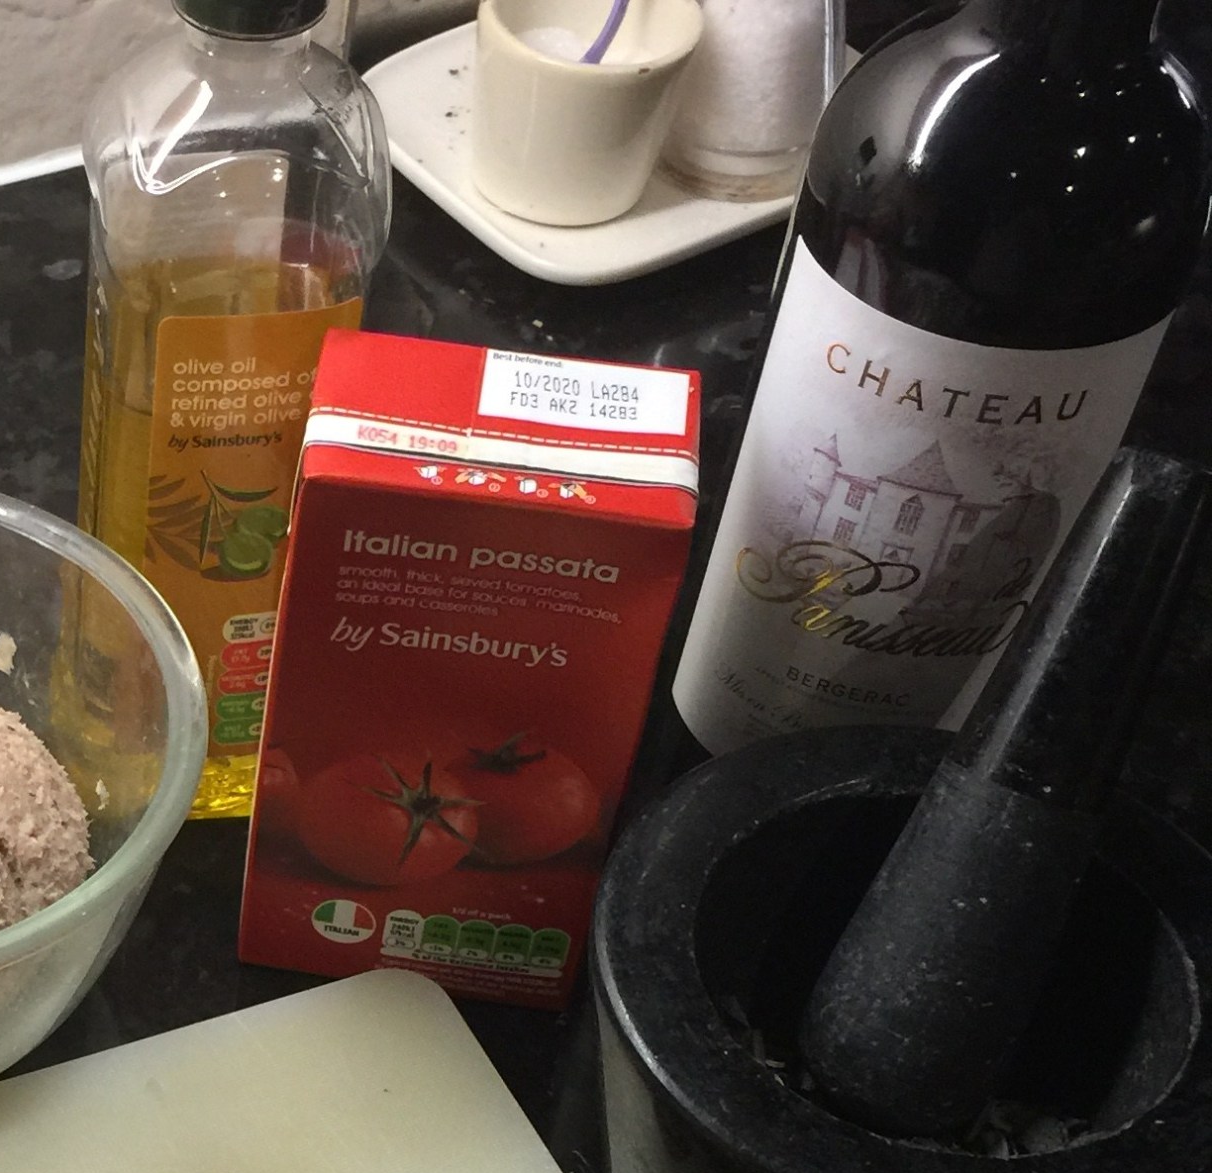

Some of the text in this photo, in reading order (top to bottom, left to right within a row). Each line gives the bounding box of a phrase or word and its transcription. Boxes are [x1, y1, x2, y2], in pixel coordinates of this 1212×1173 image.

[173, 357, 256, 375] olive oil
[515, 355, 543, 366] before
[173, 371, 290, 394] composed
[514, 370, 640, 404] 10/2020 LA284
[827, 343, 1088, 425] CHATEAU
[171, 394, 247, 411] refined
[253, 390, 303, 408] olive
[549, 397, 578, 415] AK2
[170, 407, 303, 431] & virgin olive
[168, 431, 283, 453] by Sainsbury's
[409, 435, 458, 453] 19:09
[344, 529, 620, 584] Italian passata
[337, 577, 358, 588] an
[362, 578, 401, 592] ideal
[404, 583, 444, 597] base
[448, 586, 469, 600] for
[450, 574, 501, 590] sieved
[336, 592, 499, 617] soups and casseroles
[330, 616, 568, 668] by Sainsbury's
[786, 665, 911, 707] BERGERAC
[324, 924, 360, 938] ITALIAN
